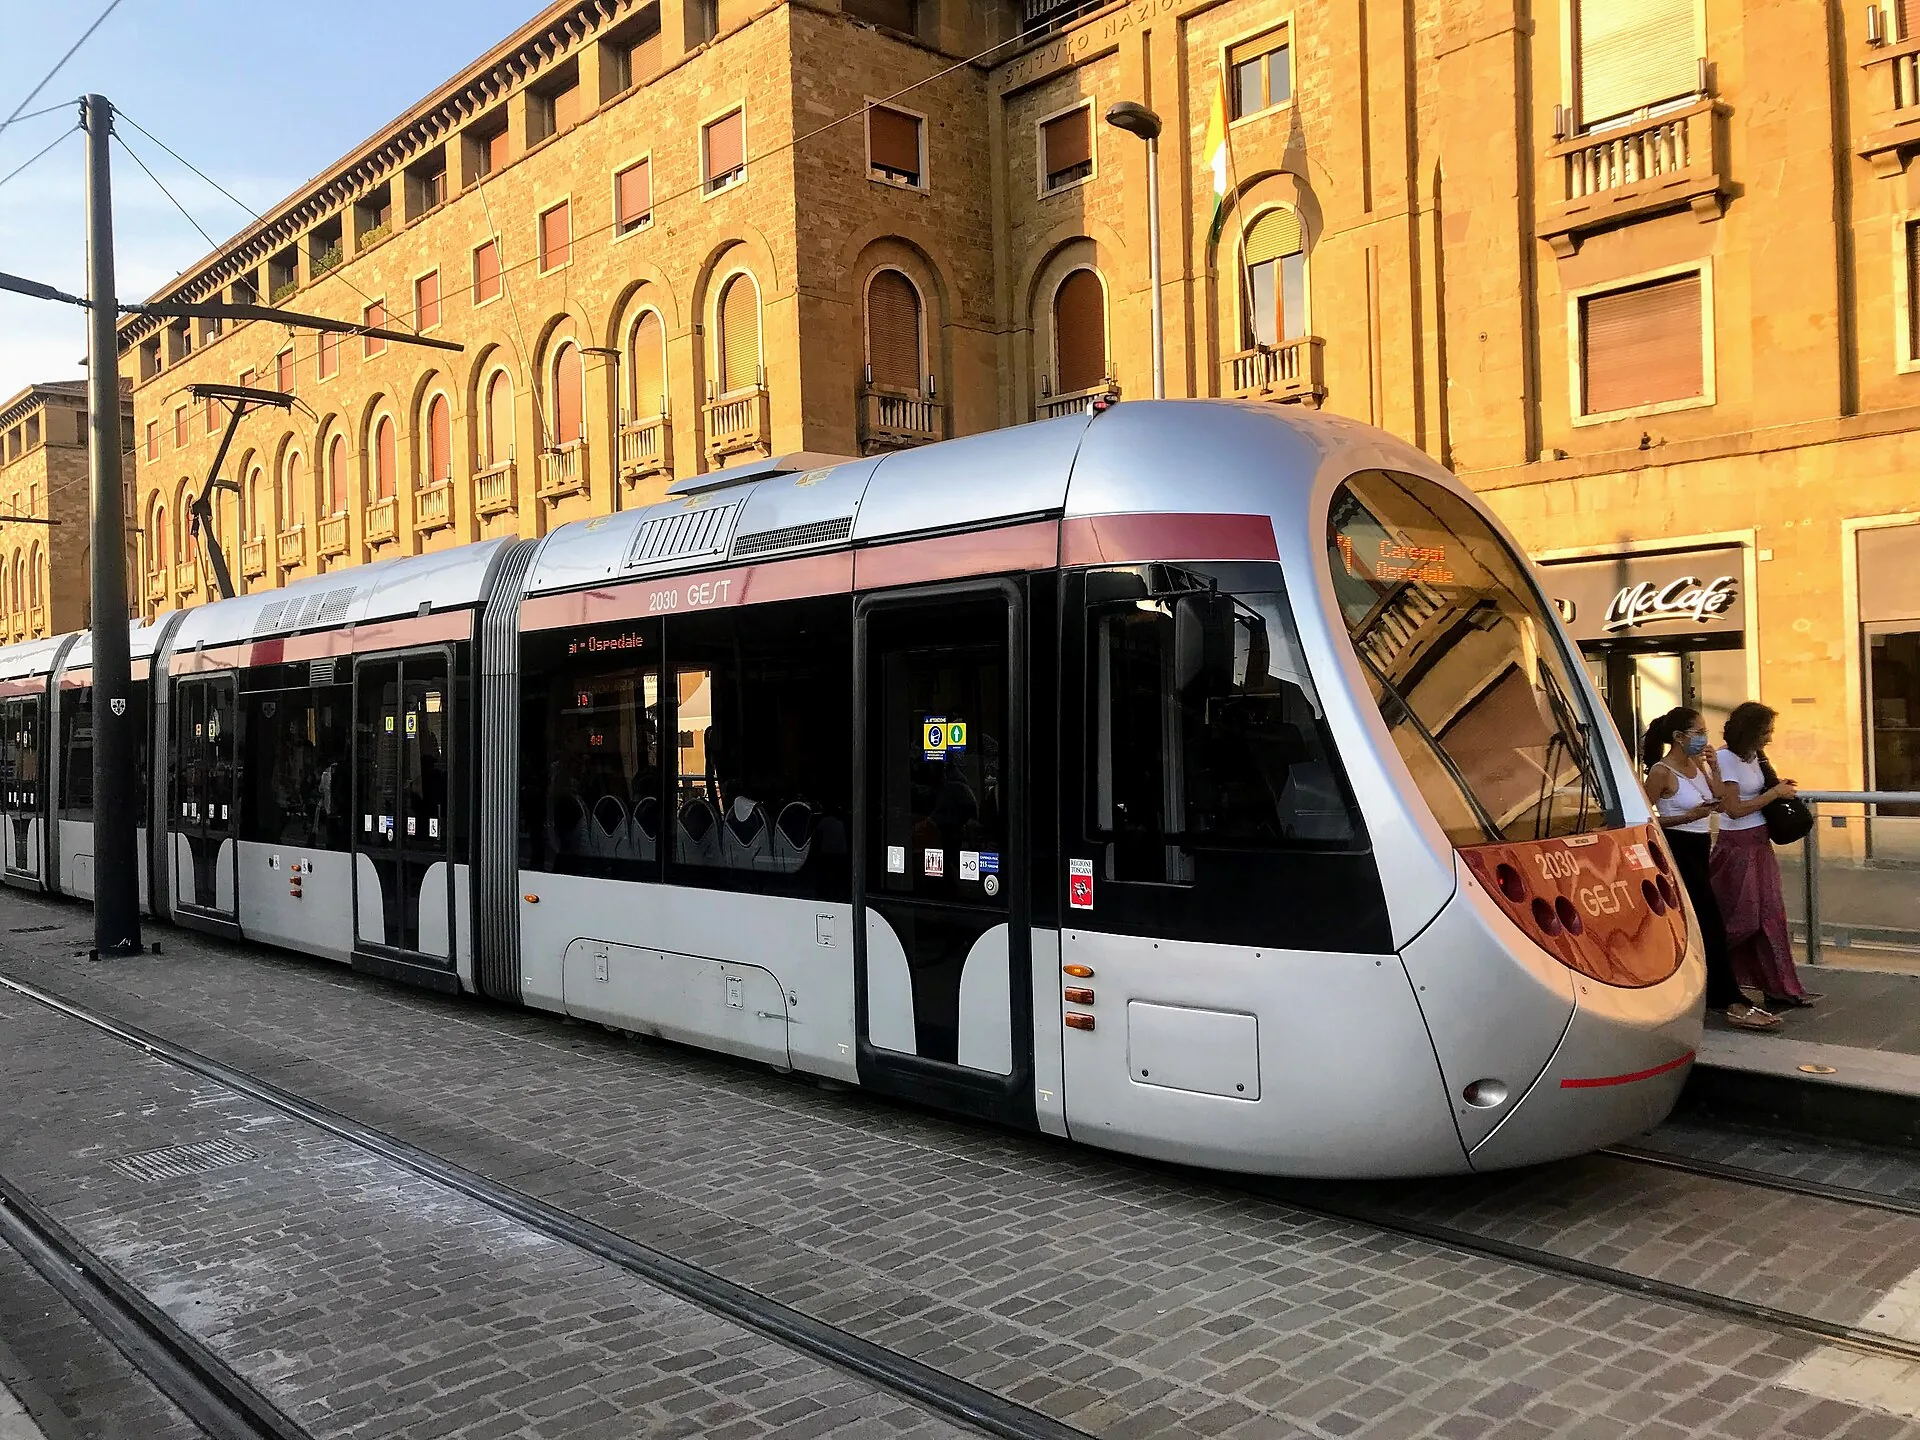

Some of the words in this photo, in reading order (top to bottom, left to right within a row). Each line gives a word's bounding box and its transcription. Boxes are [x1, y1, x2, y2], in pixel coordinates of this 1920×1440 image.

[1104, 0, 1182, 39] NAZIO
[1376, 560, 1454, 583] Ospedale
[649, 589, 678, 611] 2030
[687, 579, 731, 605] GEST
[1603, 576, 1736, 629] McCafé
[588, 631, 644, 652] Ospedale
[1535, 850, 1581, 880] 2030
[1580, 880, 1636, 917] GEST
